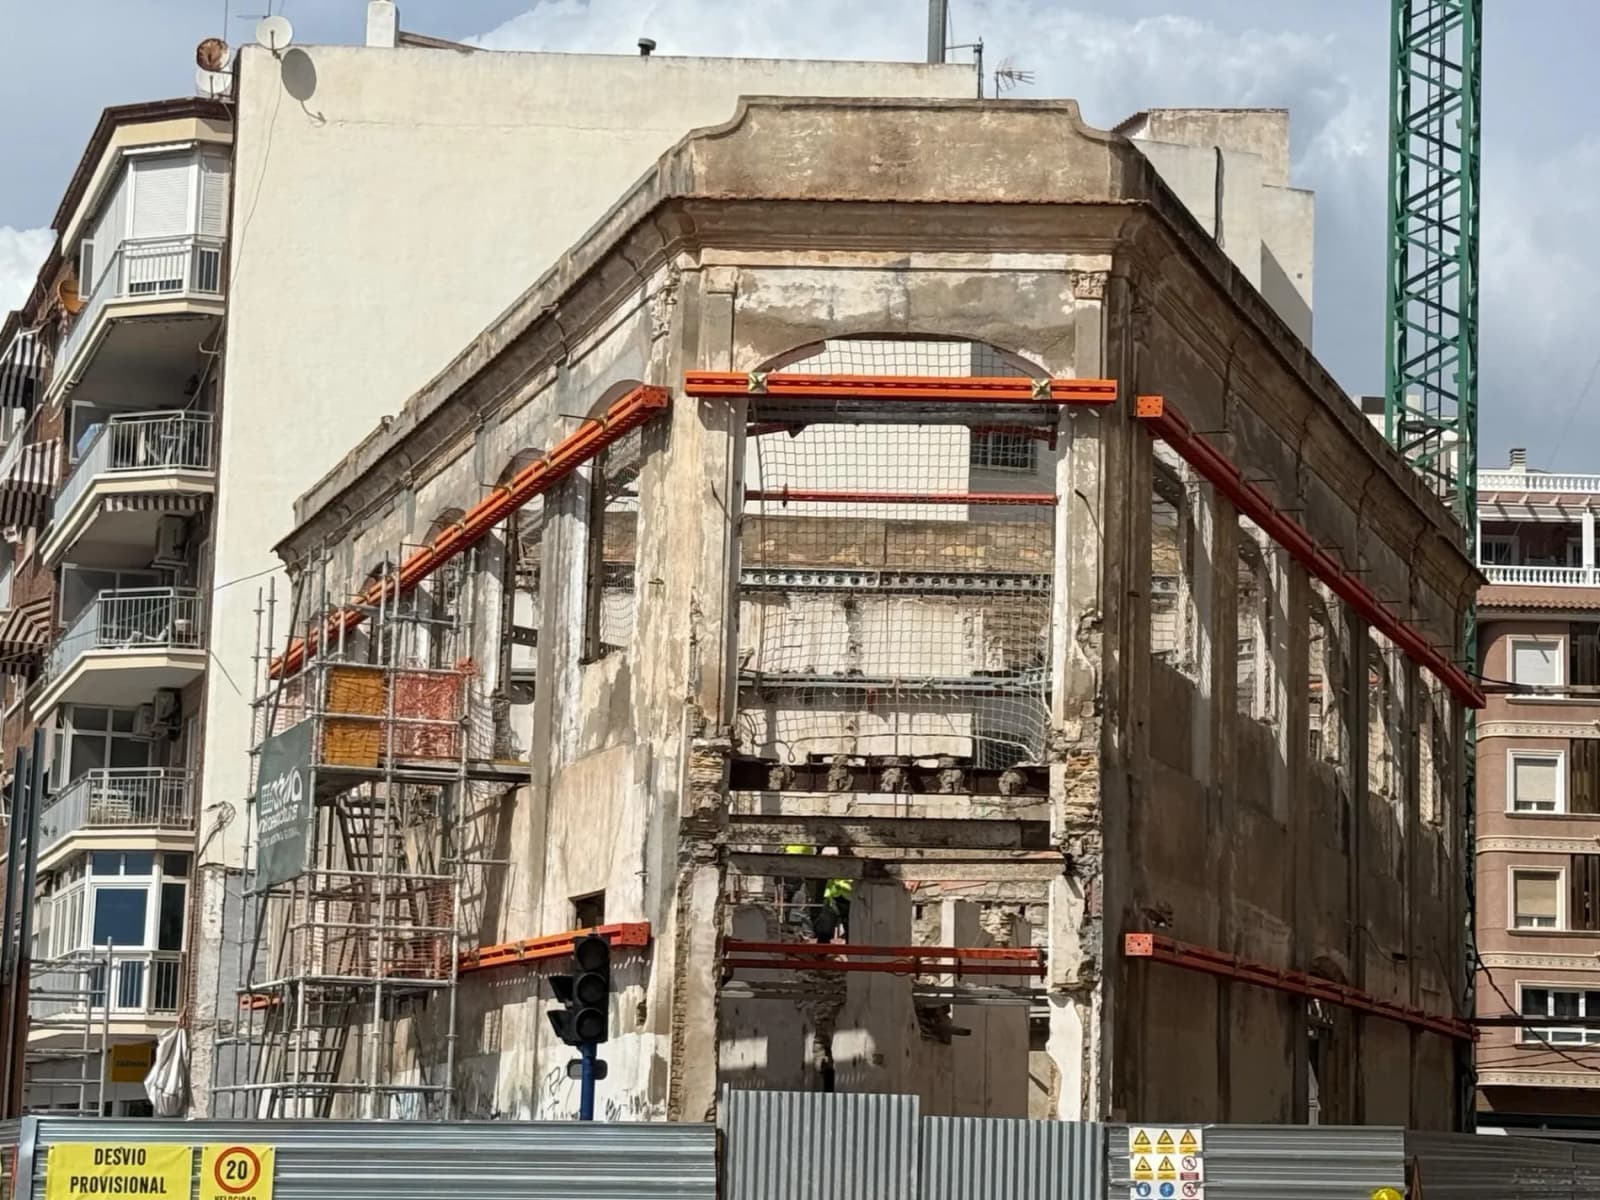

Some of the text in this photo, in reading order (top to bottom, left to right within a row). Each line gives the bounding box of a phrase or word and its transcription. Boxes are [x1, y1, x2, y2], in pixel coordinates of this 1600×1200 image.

[94, 1148, 146, 1166] DESVIO
[226, 1160, 248, 1180] 20
[70, 1176, 167, 1194] PROVISIONAL
